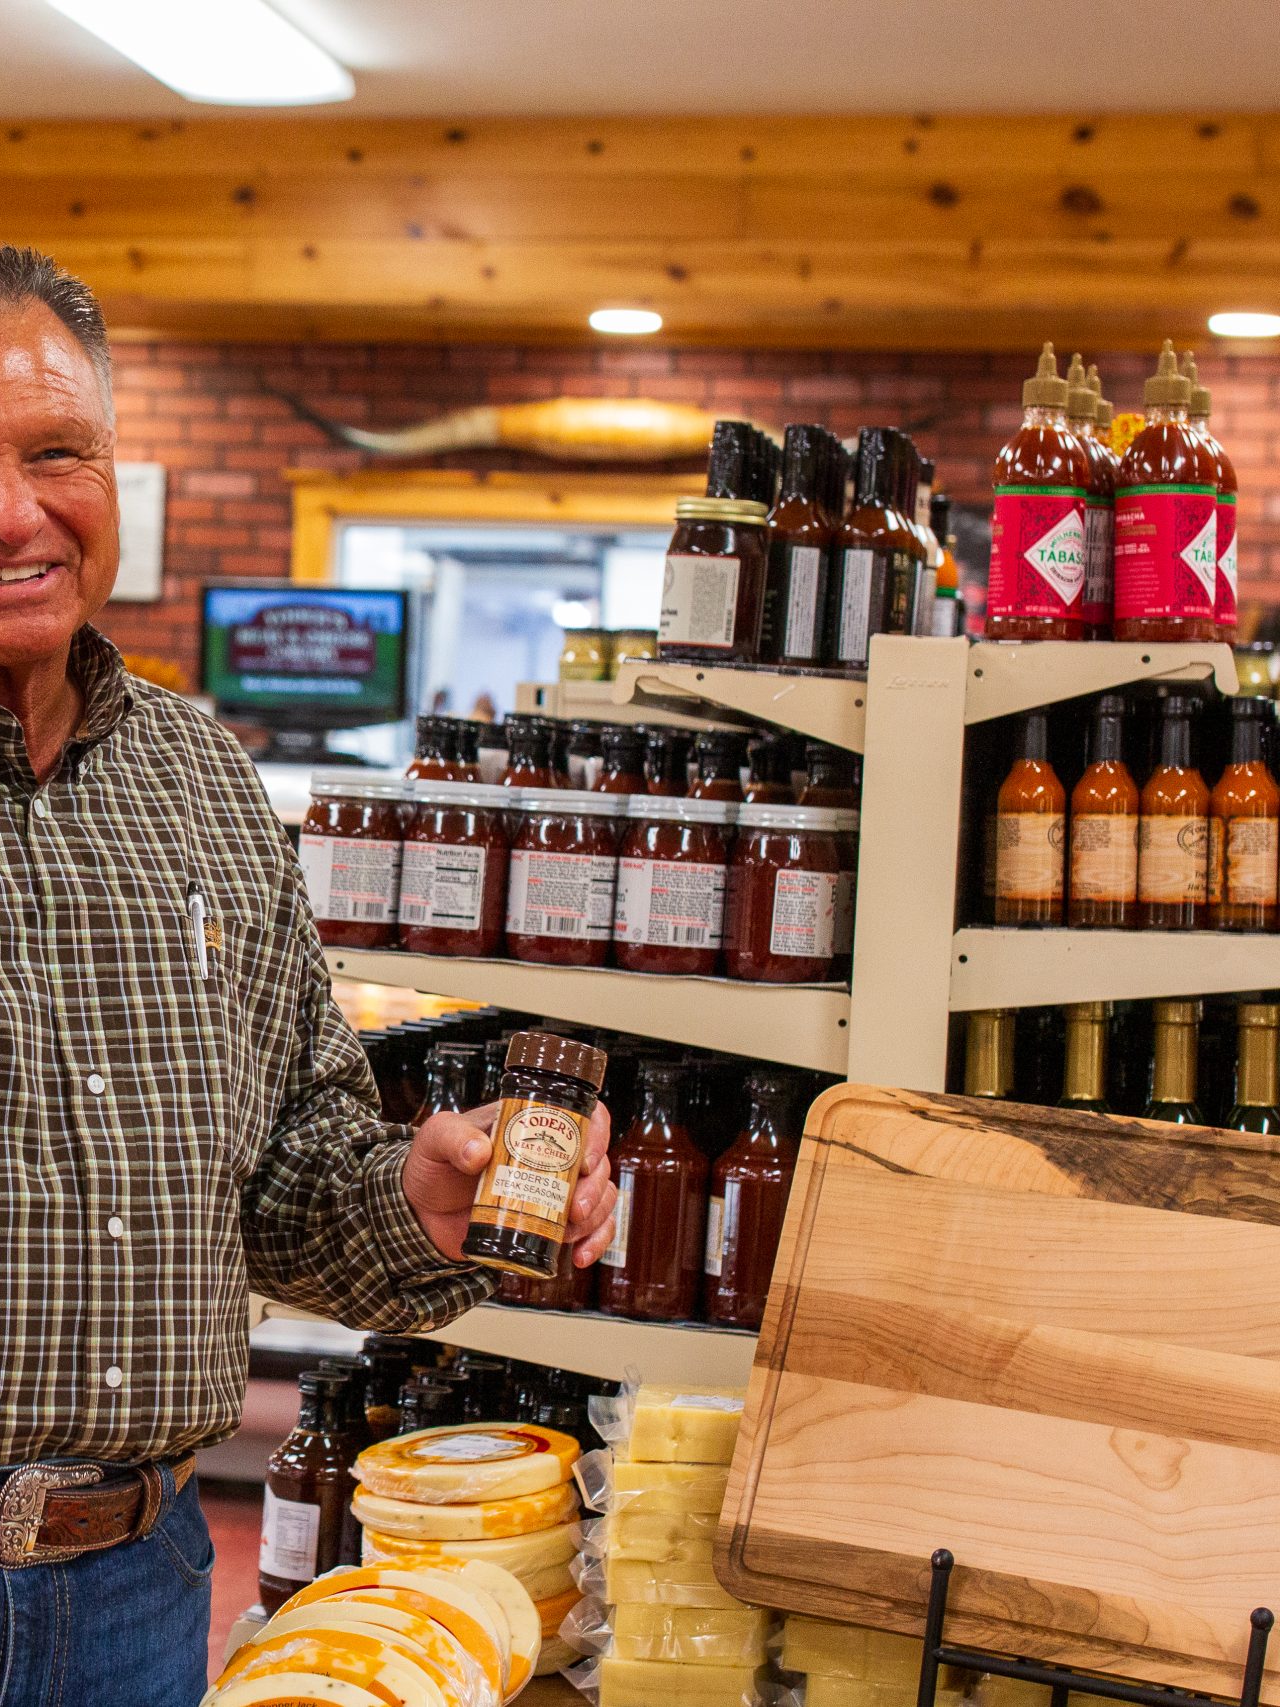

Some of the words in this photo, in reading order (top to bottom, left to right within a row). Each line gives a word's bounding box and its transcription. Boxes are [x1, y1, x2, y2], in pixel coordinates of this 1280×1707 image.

[1038, 548, 1085, 565] TABAS
[519, 1116, 575, 1141] YODER'S
[514, 1141, 535, 1151] MEAT
[544, 1147, 571, 1161] CHEESE
[495, 1178, 521, 1190] STEAK
[523, 1183, 566, 1204] SEASONING
[507, 1168, 550, 1187] YODER'S
[551, 1180, 561, 1191] DL
